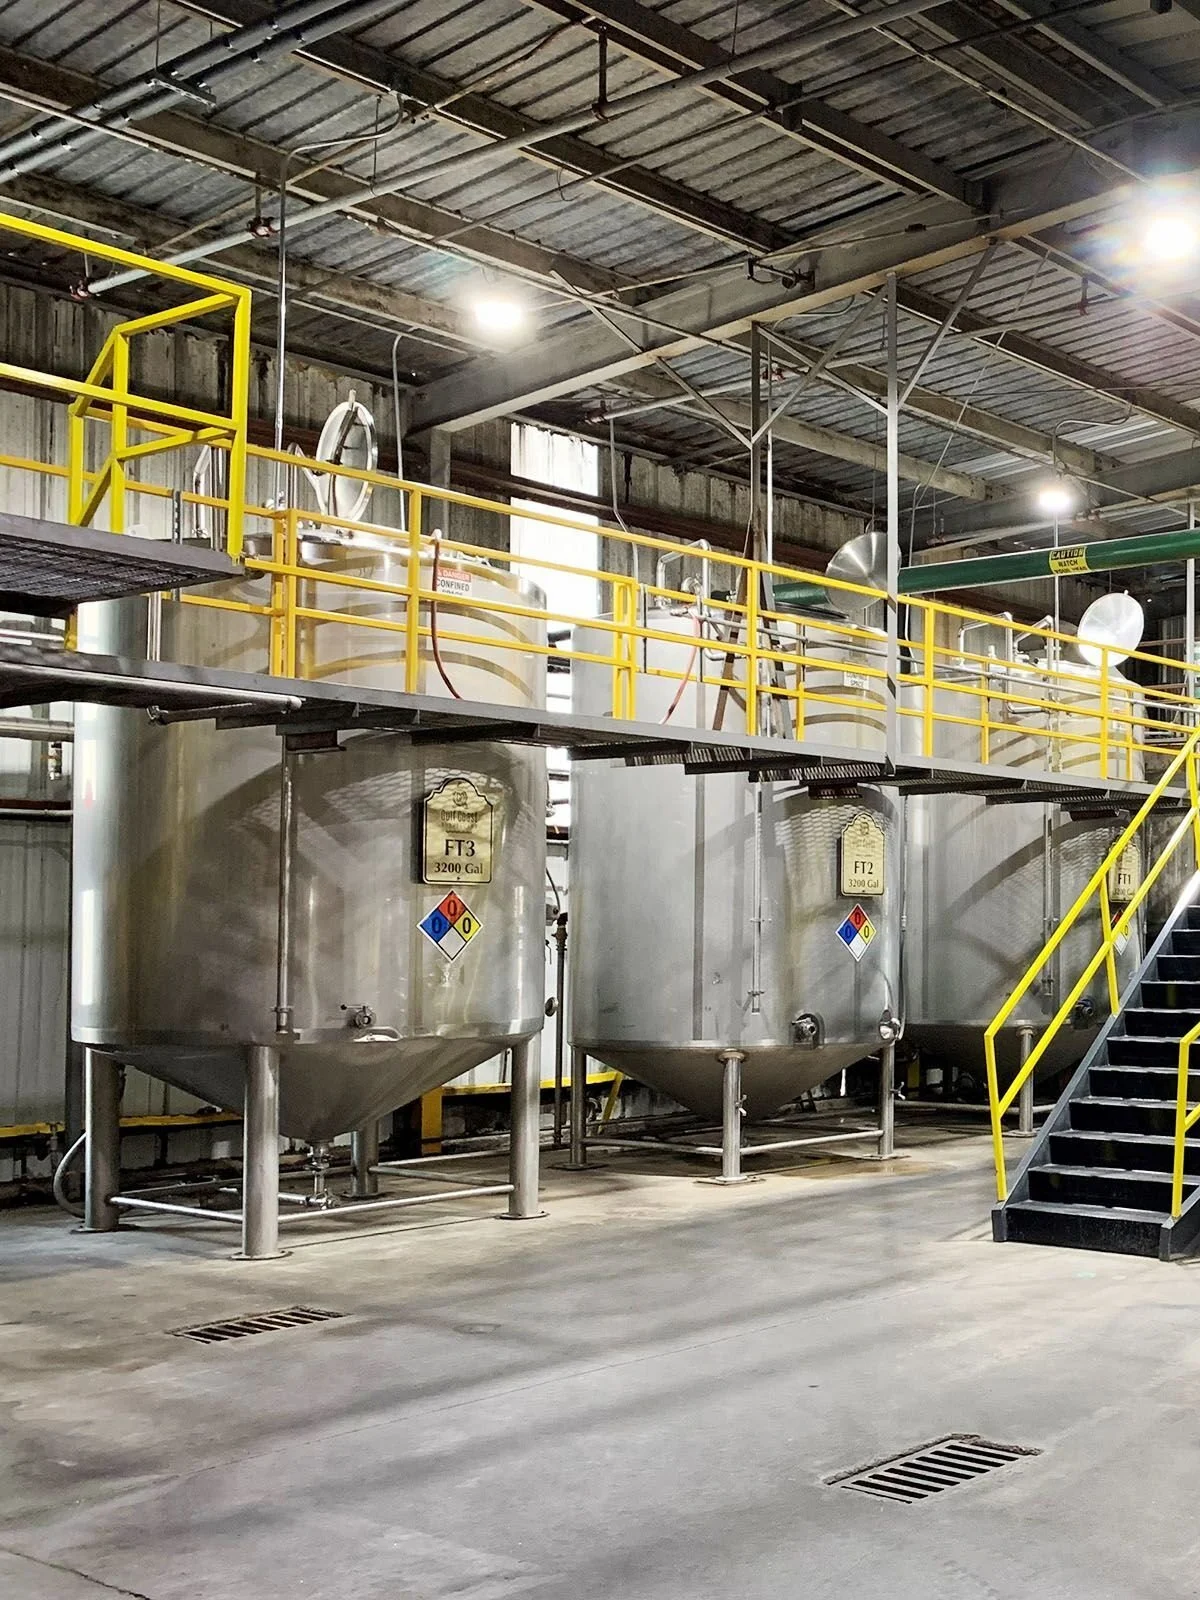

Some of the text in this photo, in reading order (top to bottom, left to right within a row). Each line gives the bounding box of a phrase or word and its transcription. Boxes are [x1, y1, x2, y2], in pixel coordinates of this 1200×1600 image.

[1051, 549, 1084, 560] CAUTION
[442, 570, 470, 581] DANGER
[445, 839, 476, 857] FT3
[434, 862, 483, 874] 3200 Gal
[854, 861, 873, 875] FT2
[848, 879, 879, 889] 3200 Gal
[1118, 874, 1131, 885] FT1
[448, 899, 457, 916] 0
[855, 912, 862, 925] 0
[432, 917, 472, 934] 0 0
[845, 925, 870, 938] 0 0
